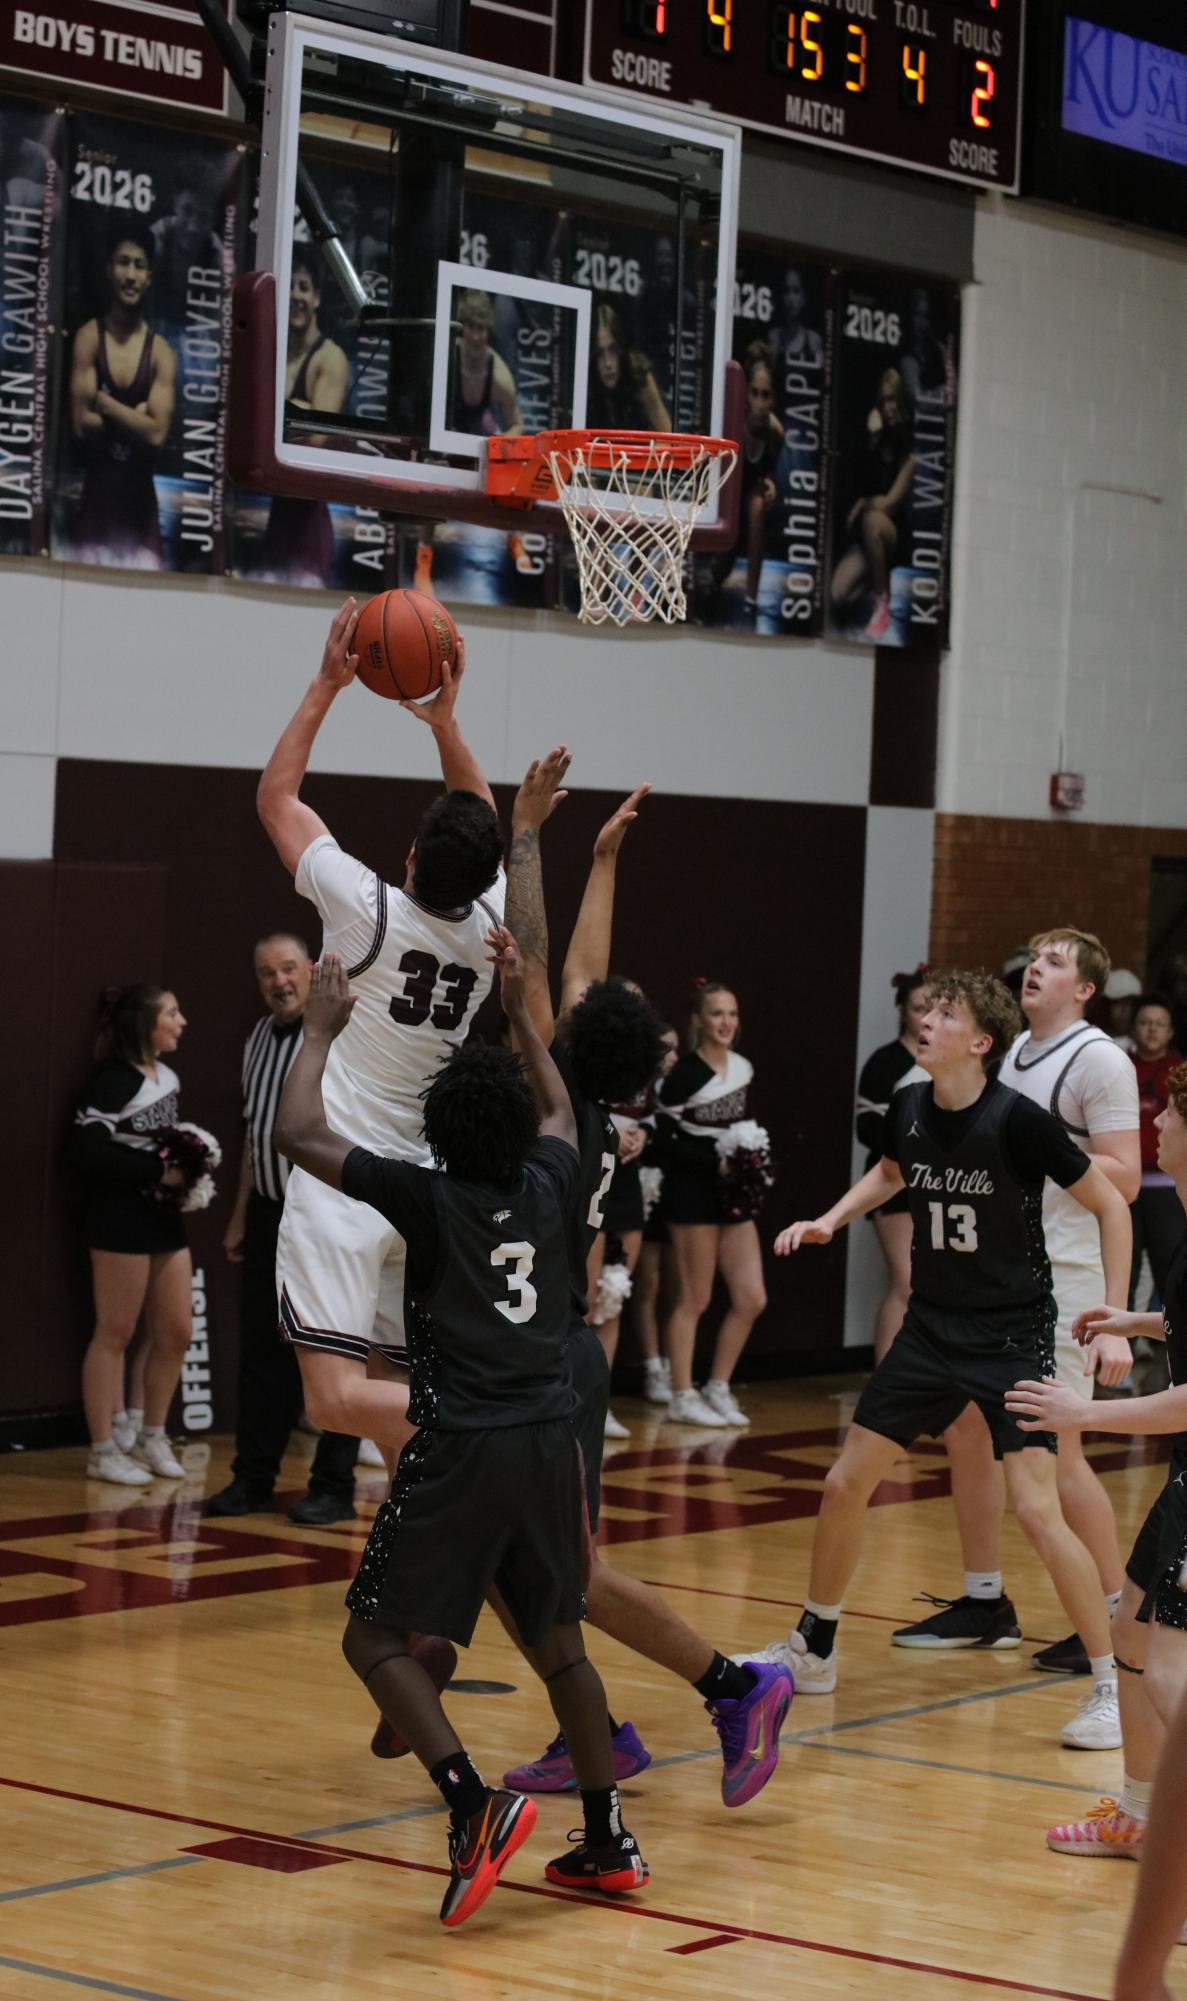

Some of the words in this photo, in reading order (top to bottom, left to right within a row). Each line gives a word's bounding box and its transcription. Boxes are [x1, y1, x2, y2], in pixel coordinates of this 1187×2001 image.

[13, 10, 96, 57] BOYS
[100, 29, 203, 80] TENNIS
[953, 18, 1002, 57] FOULS
[612, 49, 671, 91] SCORE
[903, 45, 925, 104] 4
[971, 60, 994, 128] 2
[1066, 17, 1141, 129] KU
[1145, 66, 1187, 125] SA
[785, 94, 844, 136] MATCH
[72, 162, 155, 213] 2026
[949, 138, 998, 176] SCORE
[2, 205, 43, 354] GAWITH
[460, 230, 490, 268] 26
[574, 250, 642, 296] 2026
[36, 257, 51, 321] SCHOOL
[35, 327, 48, 369] HIGH
[183, 266, 221, 403] GLOVER
[221, 292, 234, 358] SCHOOL
[844, 304, 901, 346] 2026
[32, 375, 47, 442] CENTRAL
[785, 348, 823, 451] CAPE
[0, 370, 35, 520] DAYGEN
[214, 410, 228, 473] CENTRAL
[912, 388, 945, 509] WAITE
[31, 450, 43, 504] SALINA
[180, 418, 217, 552] JULIAN
[213, 477, 225, 532] SALINA
[516, 533, 547, 575] CO
[781, 469, 820, 620] Sophia
[910, 530, 943, 624] KODI
[388, 949, 479, 1031] 33
[908, 1162, 944, 1190] The
[945, 1167, 995, 1195] Ville
[928, 1201, 978, 1253] 13
[490, 1241, 538, 1325] 3
